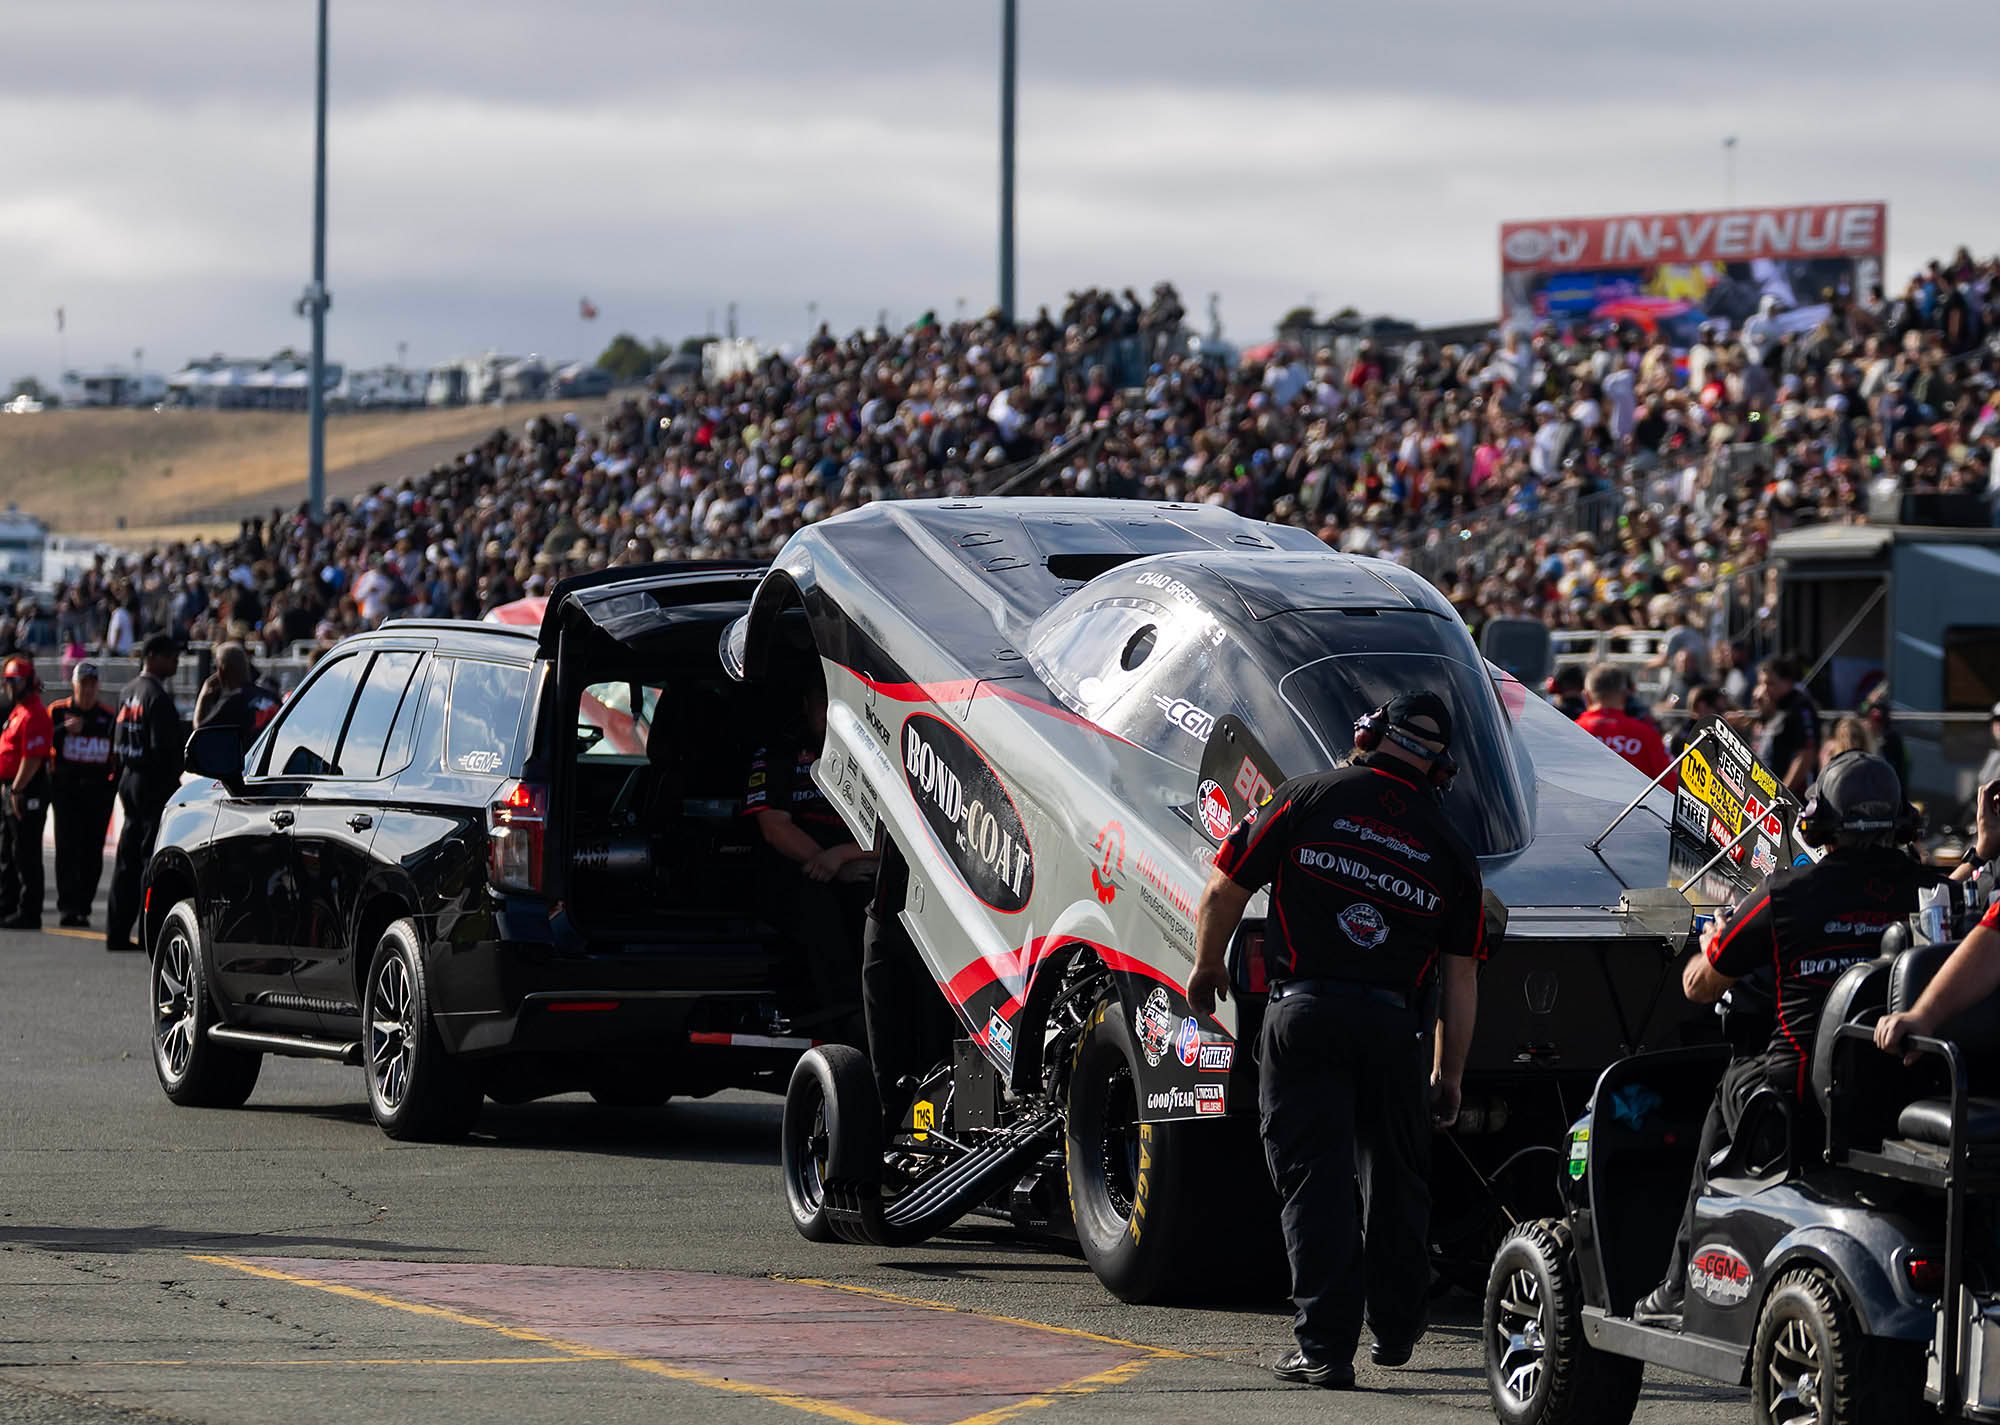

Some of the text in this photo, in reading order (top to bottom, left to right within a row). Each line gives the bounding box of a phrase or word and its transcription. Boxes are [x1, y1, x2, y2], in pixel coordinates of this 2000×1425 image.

[1603, 206, 1878, 260] IN-VENUE
[1135, 572, 1172, 589] CHAD
[464, 752, 497, 773] CGM
[1687, 754, 1707, 788] TMS
[1718, 751, 1746, 793] JESEL
[906, 723, 1031, 899] BOND-COAT
[1680, 794, 1707, 830] FIRE
[1709, 778, 1742, 824] BULLET
[1711, 818, 1743, 858] MANY
[1299, 847, 1441, 912] BOND-COAT
[1140, 885, 1176, 932] Manufacturing
[1174, 921, 1189, 942] parts
[1146, 1007, 1169, 1029] FLYING
[1200, 1046, 1233, 1069] ROTTLER
[1147, 1086, 1195, 1114] GOODYEAR
[1196, 1087, 1219, 1100] LINCOLN
[916, 1108, 931, 1128] TMS
[1129, 1124, 1153, 1247] EAGLE
[1705, 1255, 1738, 1280] CGM
